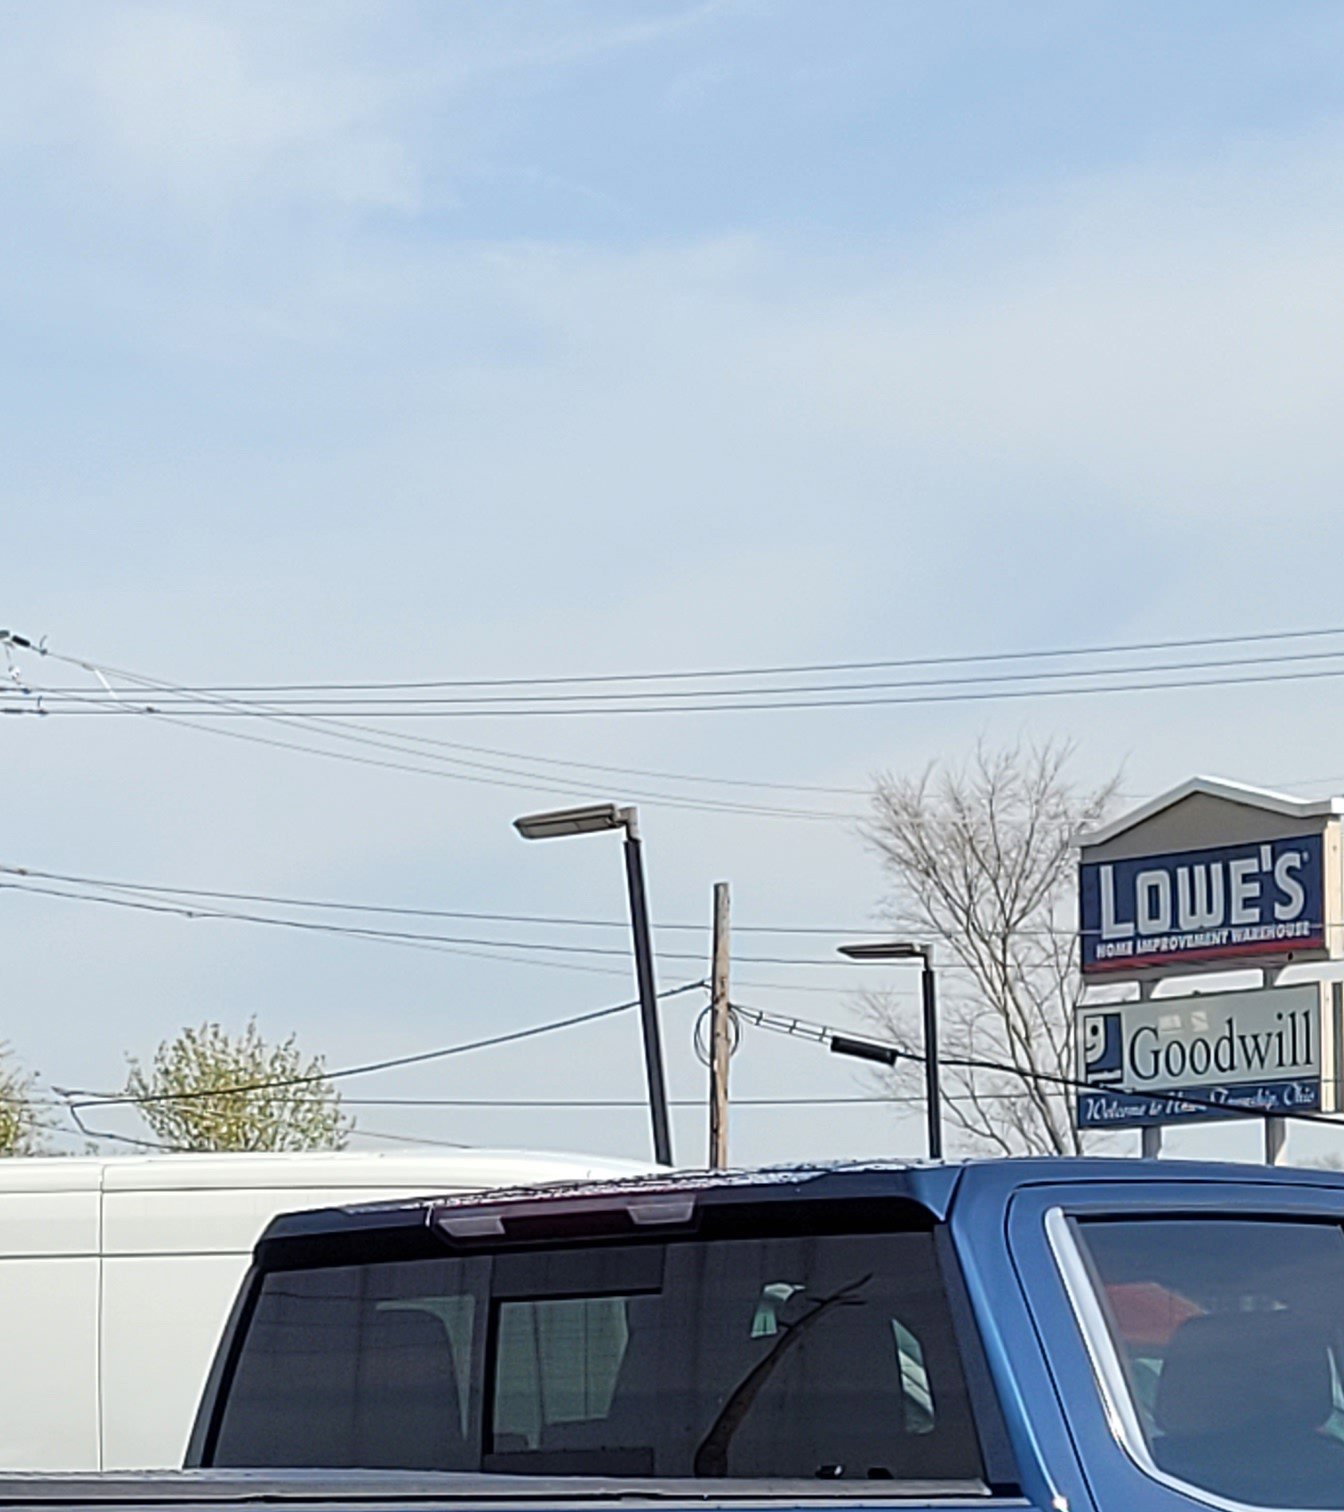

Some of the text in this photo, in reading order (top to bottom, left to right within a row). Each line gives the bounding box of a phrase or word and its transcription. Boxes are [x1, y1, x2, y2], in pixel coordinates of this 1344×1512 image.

[1099, 844, 1307, 941] LOWE'S
[1096, 921, 1311, 959] HOME IMPROVEMENT WAREHOUSE
[1129, 1009, 1314, 1081] Goodwill
[1086, 1098, 1146, 1120] Welcome
[1283, 1081, 1315, 1106] Ohio
